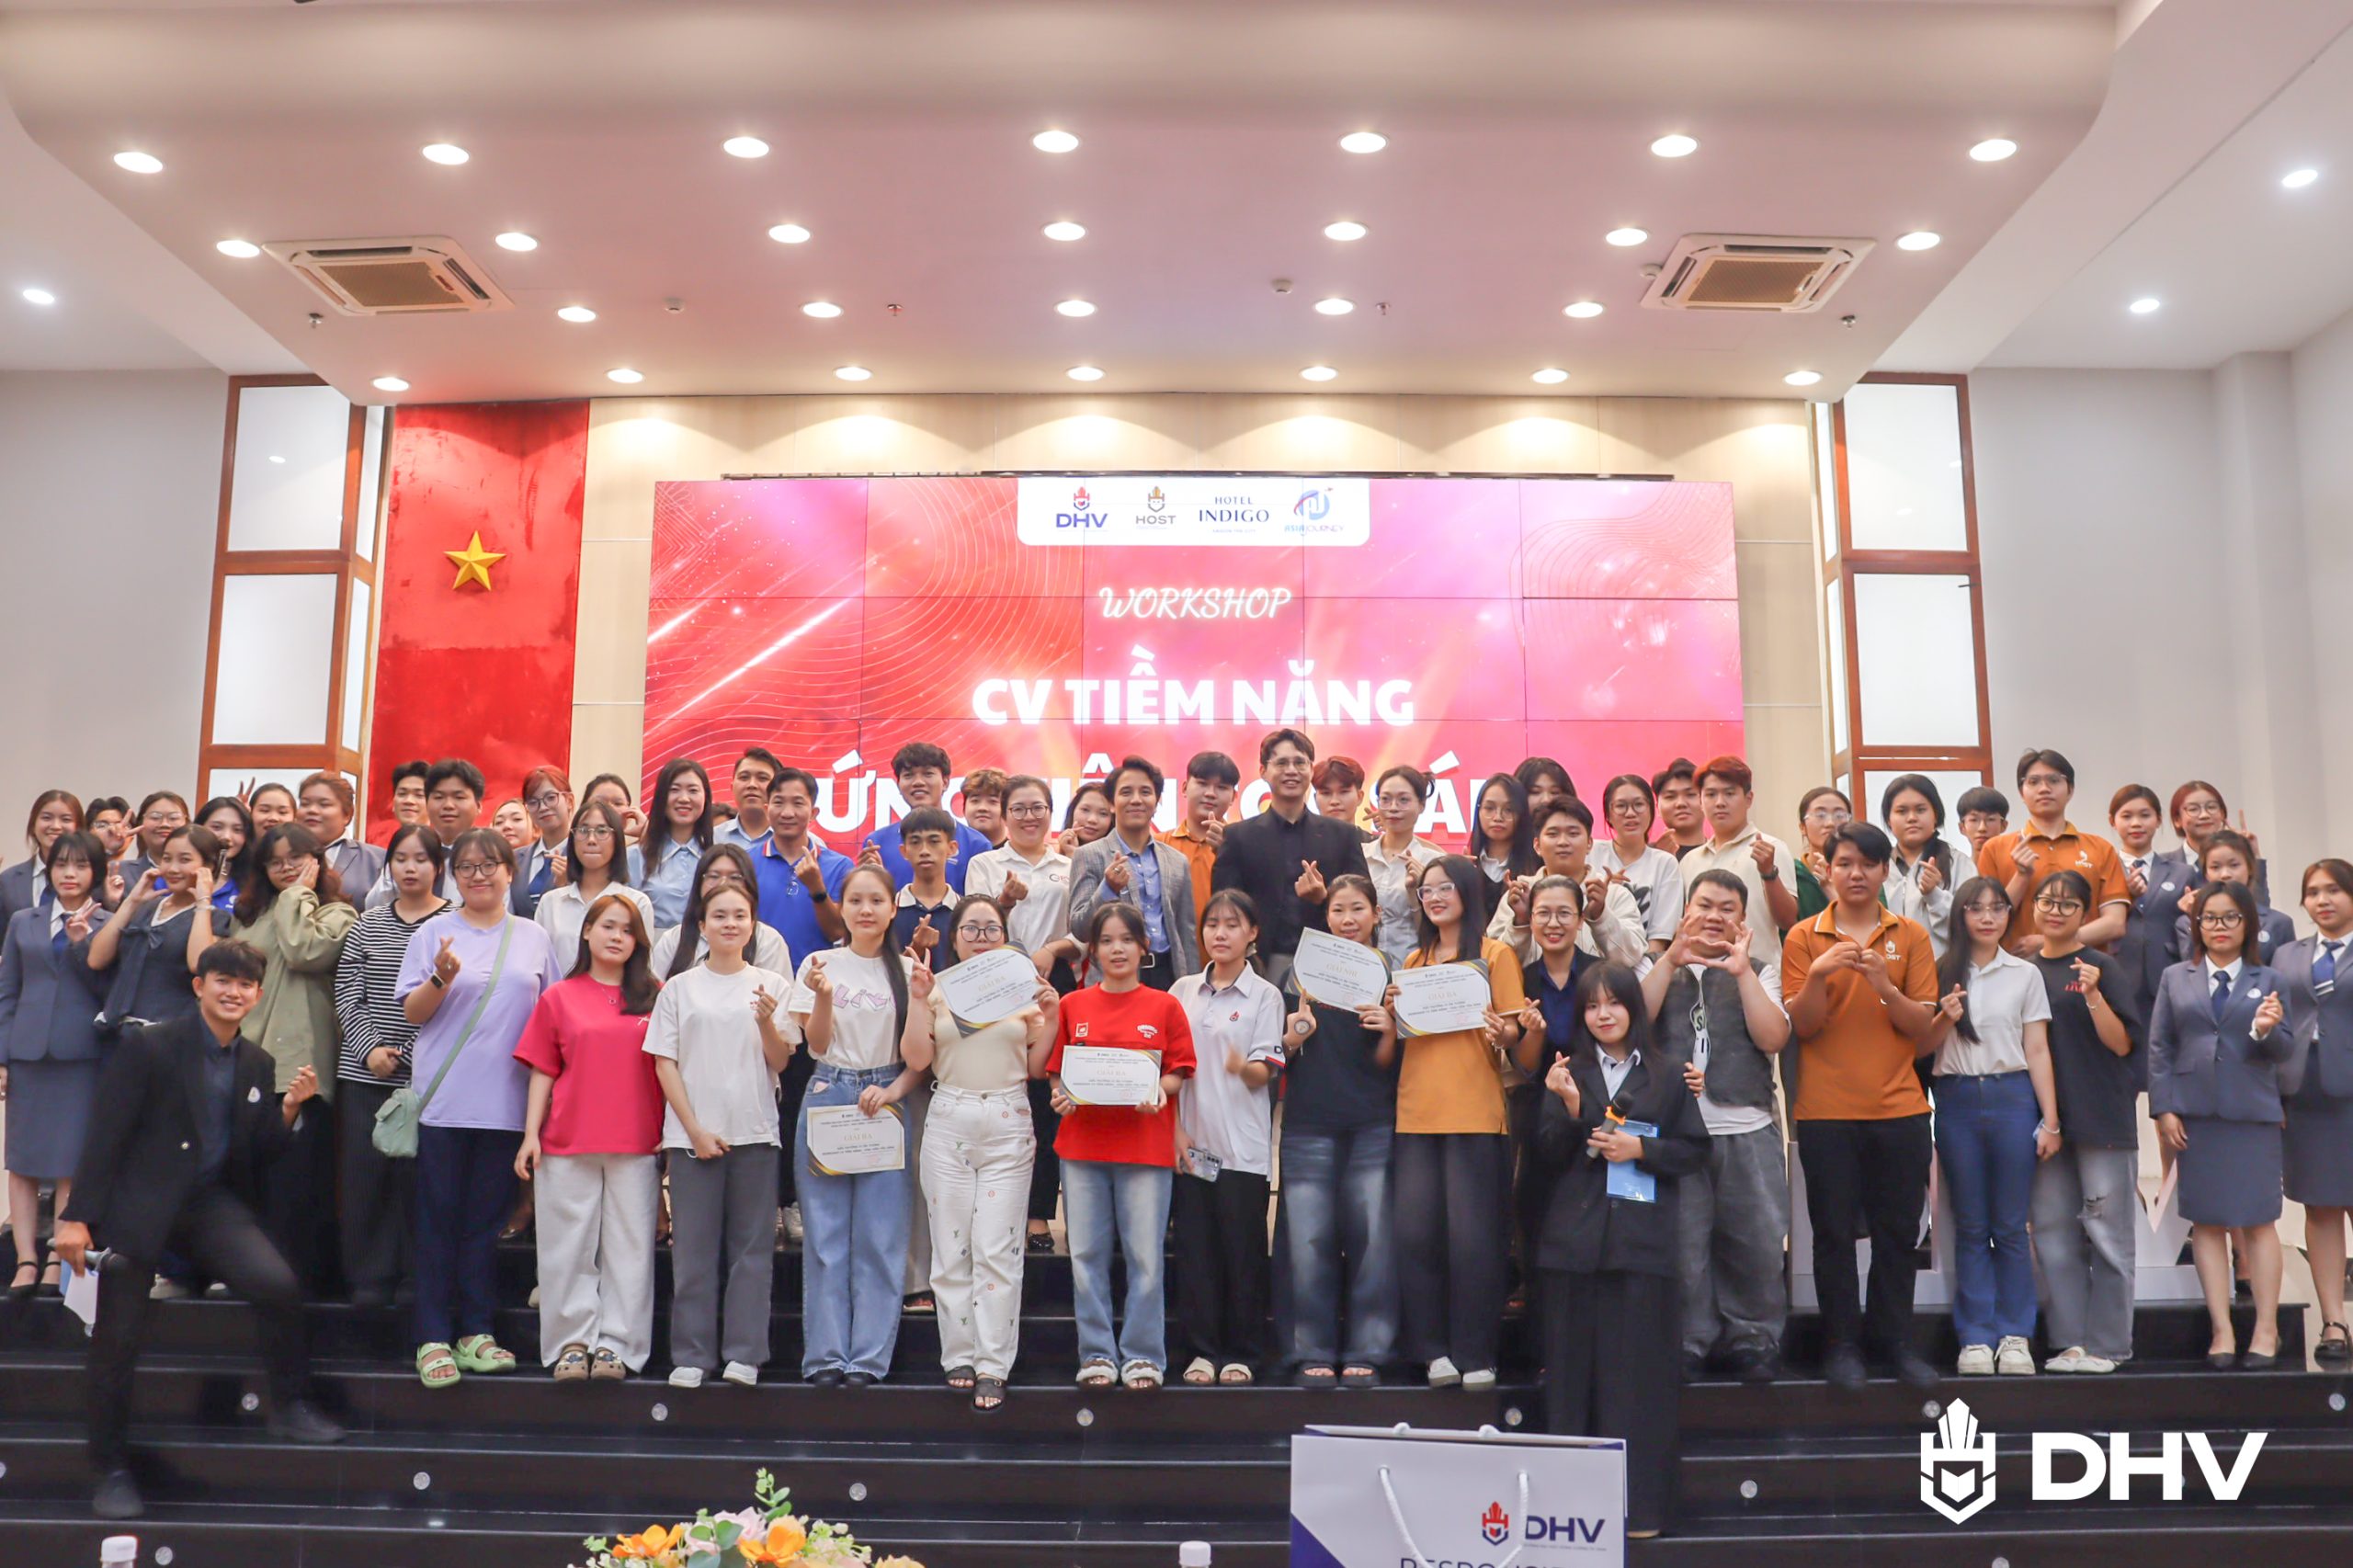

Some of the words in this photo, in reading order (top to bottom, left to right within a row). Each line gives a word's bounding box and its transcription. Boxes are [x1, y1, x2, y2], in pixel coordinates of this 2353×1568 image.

[1215, 496, 1253, 505] HOTEL
[1056, 513, 1108, 528] DHV
[1136, 515, 1176, 525] HOST
[1199, 509, 1269, 522] INDIGO
[1098, 586, 1291, 619] WORKSHOP
[972, 678, 1052, 725] CV
[1064, 644, 1215, 725] TIỀM
[1233, 660, 1415, 727] NĂNG
[1525, 1516, 1606, 1543] DHV
